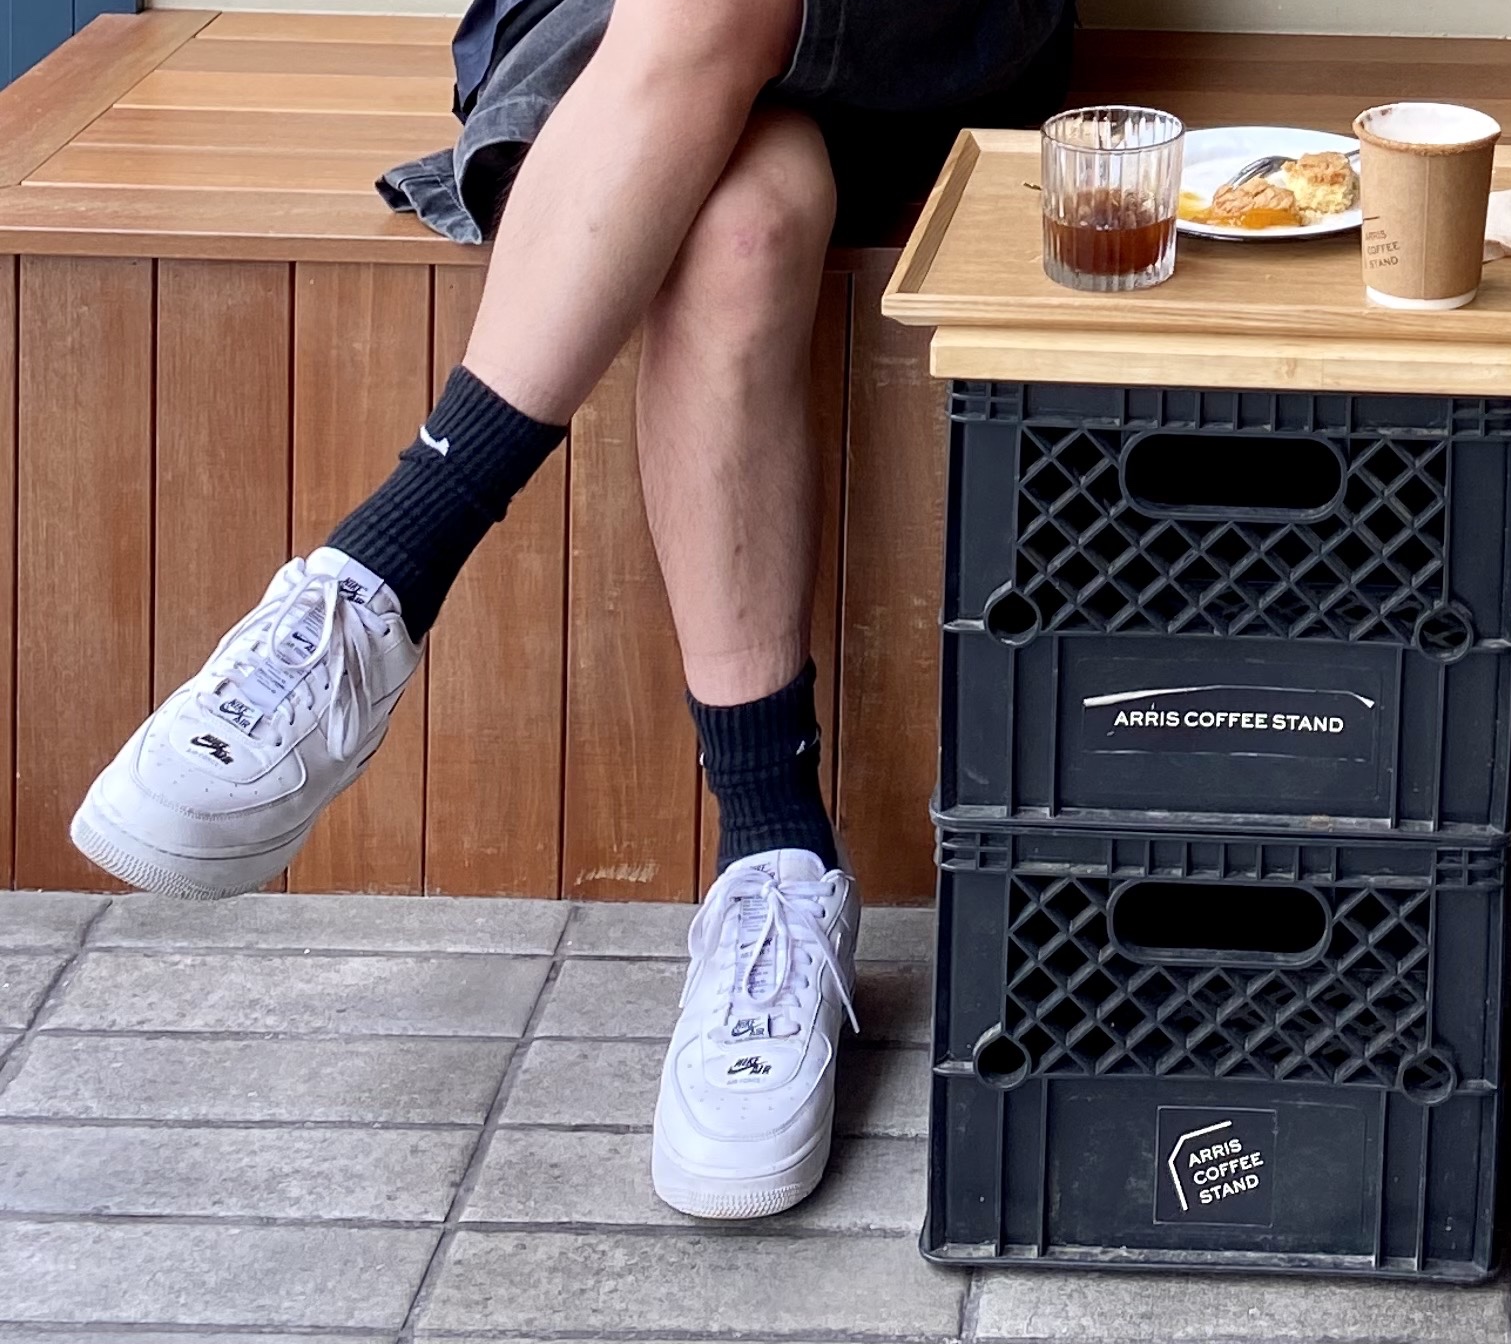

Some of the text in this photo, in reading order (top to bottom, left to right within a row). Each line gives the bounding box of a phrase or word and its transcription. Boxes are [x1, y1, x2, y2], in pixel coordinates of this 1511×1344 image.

[1367, 241, 1400, 255] COFFEE
[1369, 256, 1399, 269] STAND
[1113, 710, 1344, 733] ARRIS COFFEE STAND
[733, 1055, 761, 1068] NIKE
[749, 1064, 772, 1075] AIR
[1188, 1138, 1242, 1168] ARRIS
[1193, 1151, 1264, 1185] COFFEE
[1199, 1174, 1260, 1204] STAND
